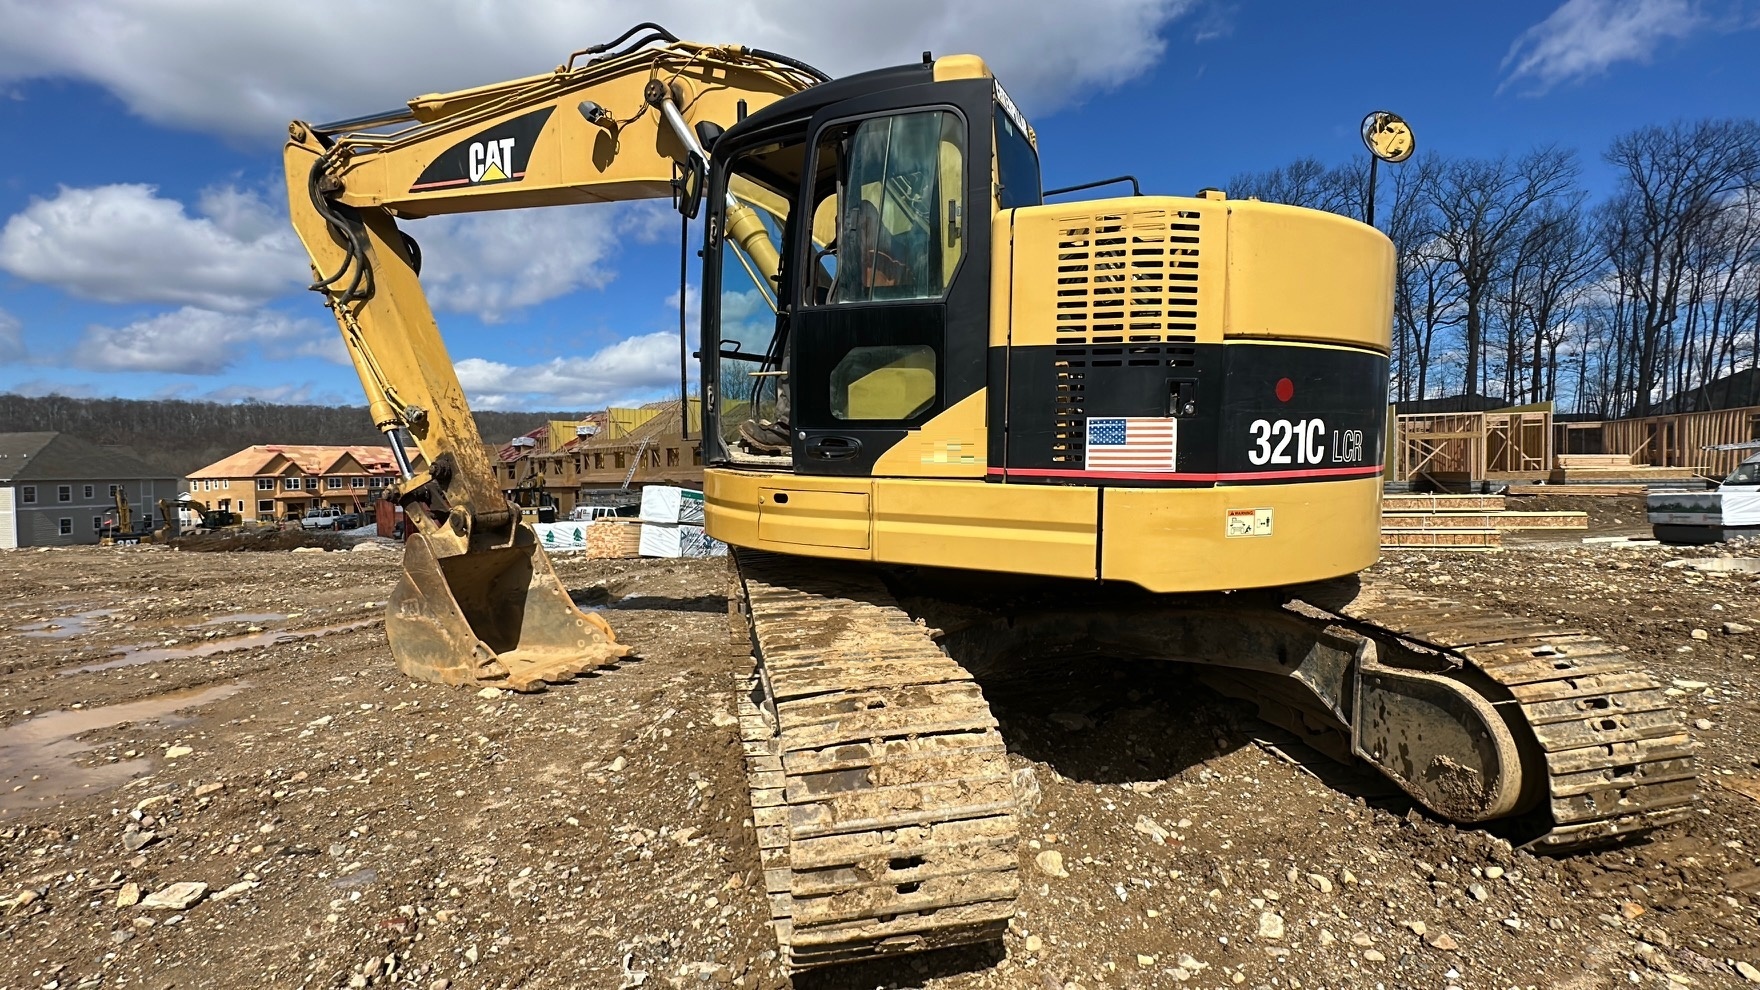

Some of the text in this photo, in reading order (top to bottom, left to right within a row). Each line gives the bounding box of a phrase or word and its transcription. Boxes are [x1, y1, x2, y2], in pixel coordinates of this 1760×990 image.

[469, 138, 515, 182] CAT
[1248, 418, 1364, 466] 321C LCR
